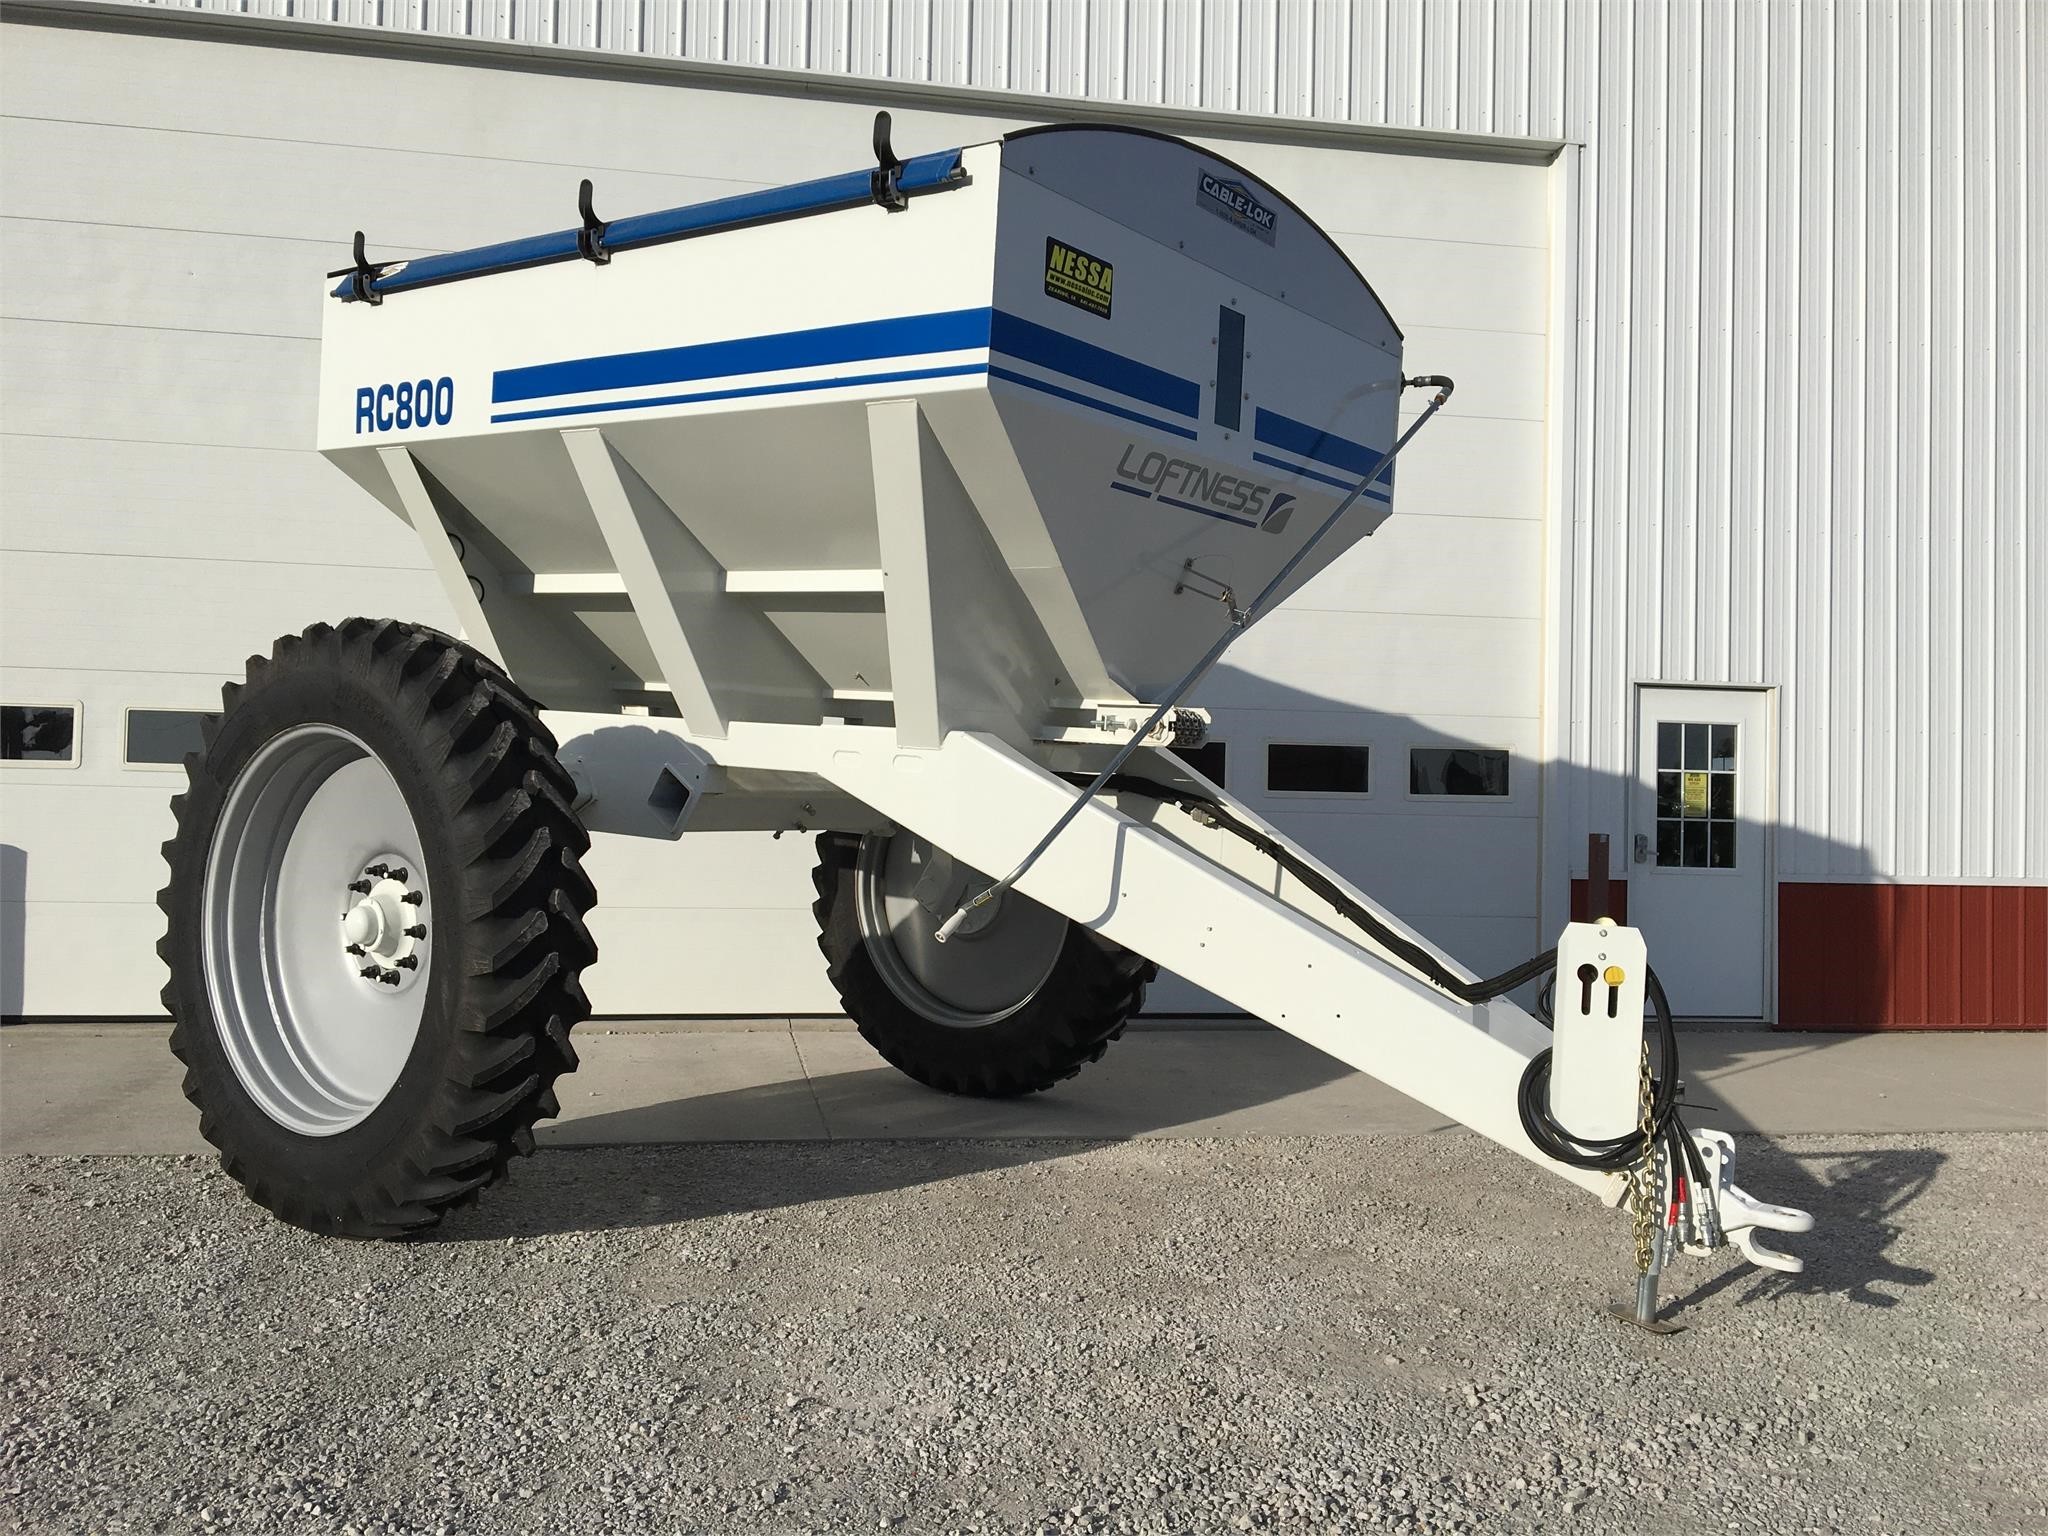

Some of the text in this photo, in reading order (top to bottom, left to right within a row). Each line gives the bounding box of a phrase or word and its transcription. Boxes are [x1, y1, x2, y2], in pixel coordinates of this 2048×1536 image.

[1049, 244, 1113, 293] NESSA
[356, 376, 454, 434] RC800
[1116, 443, 1272, 516] LOFTNESS
